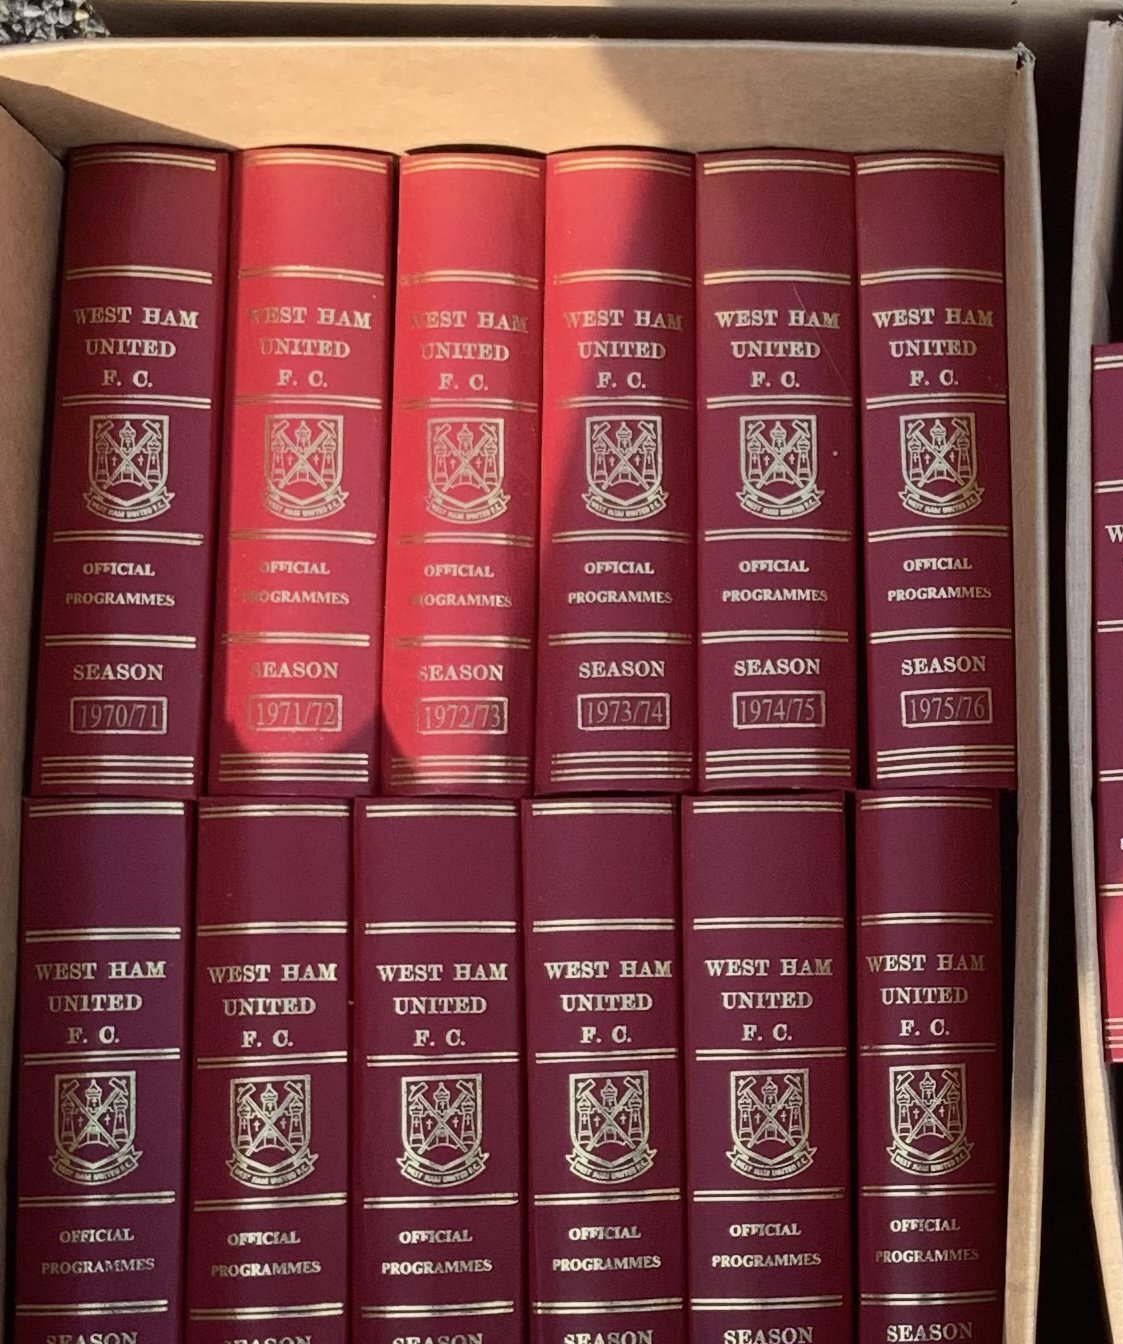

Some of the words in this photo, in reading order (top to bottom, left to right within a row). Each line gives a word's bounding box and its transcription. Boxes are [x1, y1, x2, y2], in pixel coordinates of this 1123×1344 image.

[74, 306, 132, 324] WEST
[142, 307, 199, 328] HAM
[564, 309, 624, 327] WEST
[634, 310, 682, 330] HAM
[714, 309, 779, 327] WEST
[788, 309, 840, 328] HAM
[872, 308, 934, 328] WEST
[945, 308, 993, 327] HAM
[86, 339, 176, 357] UNITED
[578, 341, 665, 359] UNITED
[731, 340, 820, 358] UNITED
[889, 339, 976, 358] UNITED
[739, 560, 809, 572] OFFICIAL
[722, 588, 827, 602] PROGRAMMES
[74, 664, 163, 680] SEASON
[419, 664, 503, 681] SEASON
[579, 661, 664, 678] SEASON
[734, 658, 820, 676] SEASON
[902, 656, 985, 675] SEASON
[78, 704, 161, 728] 1970/71
[425, 704, 504, 729] 1972/73
[584, 700, 663, 724] 1973/74
[741, 698, 819, 723] 1974/75
[910, 695, 984, 721] 1975/76
[36, 962, 97, 980] WEST
[108, 961, 166, 979] HAM
[376, 964, 443, 981] WEST
[454, 963, 508, 980] HAM
[544, 961, 609, 979] WEST
[619, 960, 672, 977] HAM
[704, 959, 769, 976] WEST
[780, 959, 832, 976] HAM
[866, 955, 926, 972] WEST
[937, 954, 984, 971] HAM
[207, 965, 271, 983] WEST
[281, 963, 337, 981] HAM
[560, 994, 652, 1012] UNITED
[721, 992, 813, 1009] UNITED
[880, 987, 967, 1005] UNITED
[223, 997, 316, 1016] UNITED
[393, 997, 487, 1015] UNITED
[569, 1226, 641, 1240] OFFICIAL
[382, 1259, 492, 1275] PROGRAMMES
[712, 1254, 821, 1267] PROGRAMMES
[887, 1324, 972, 1342] SEASON
